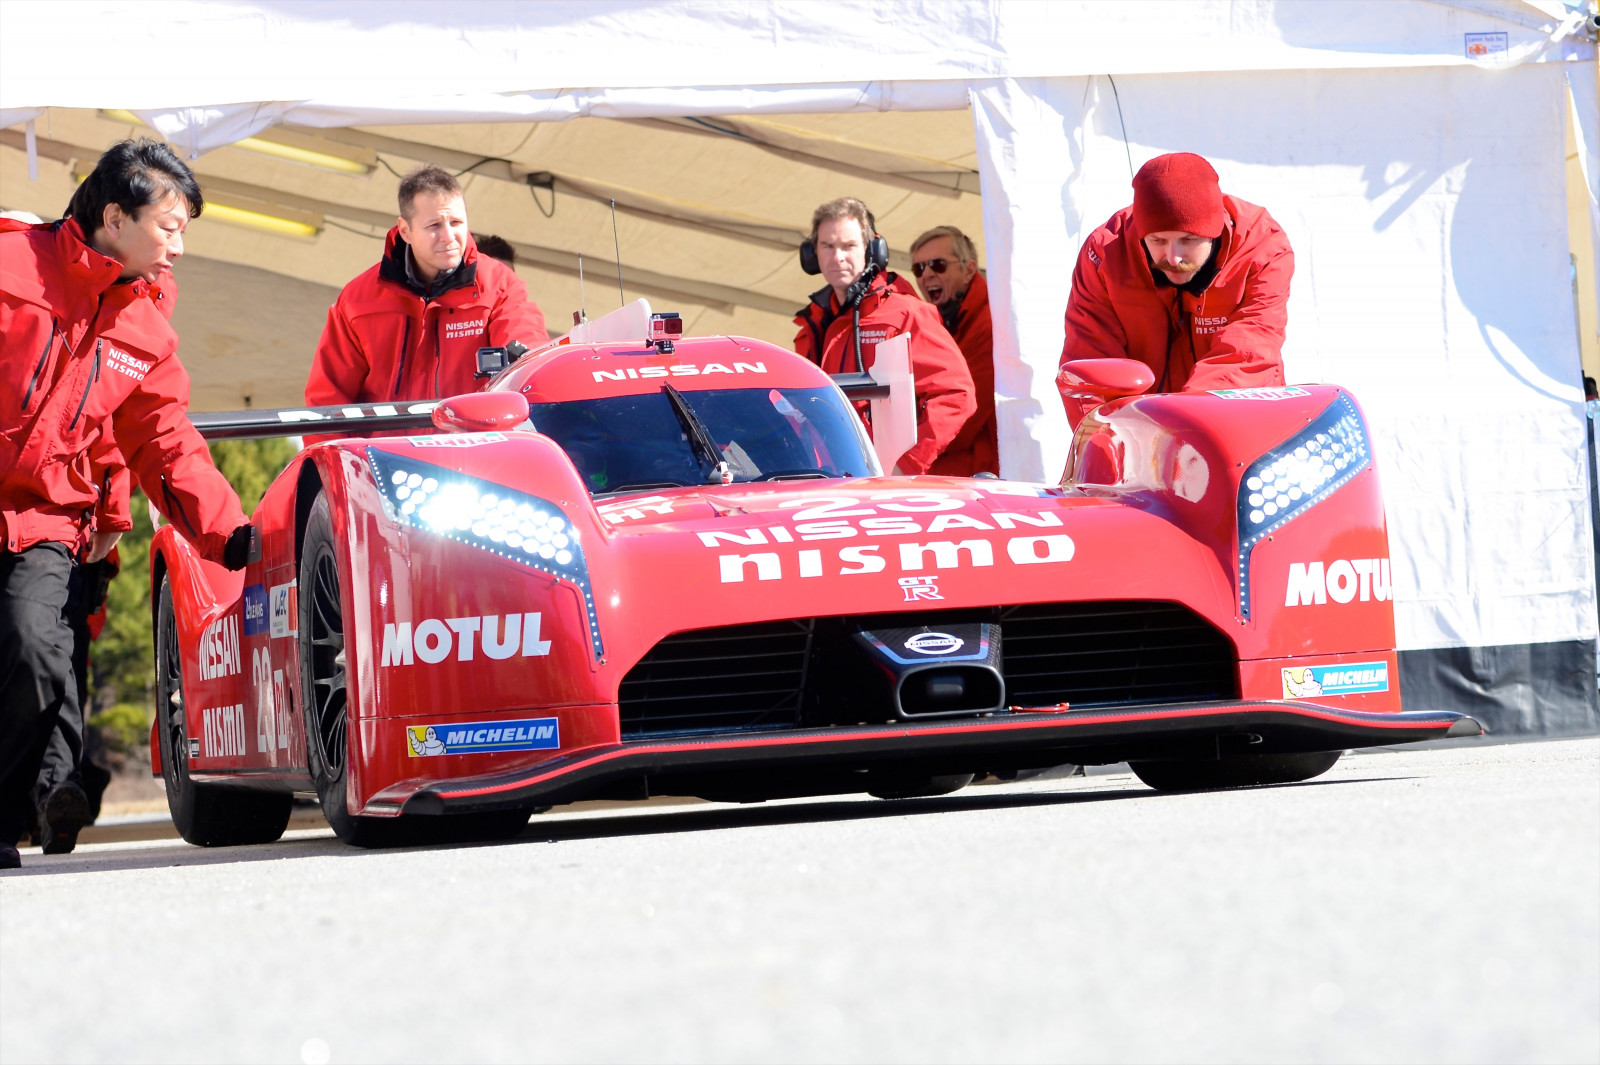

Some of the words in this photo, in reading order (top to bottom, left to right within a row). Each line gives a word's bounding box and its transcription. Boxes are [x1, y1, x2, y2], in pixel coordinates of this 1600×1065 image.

[445, 319, 484, 331] NISSAN
[1194, 317, 1228, 326] NISSA
[108, 348, 151, 373] NISSAN
[592, 361, 768, 383] NISSAN
[602, 500, 675, 524] HY
[778, 491, 966, 521] 23
[696, 511, 1065, 548] NISSAN
[897, 575, 939, 586] GT
[900, 584, 945, 602] R
[199, 613, 242, 681] NISSAN
[381, 612, 552, 667] MOTUL
[1322, 668, 1387, 686] MICHELIN
[252, 646, 276, 753] 23
[446, 725, 555, 745] MICHELIN
